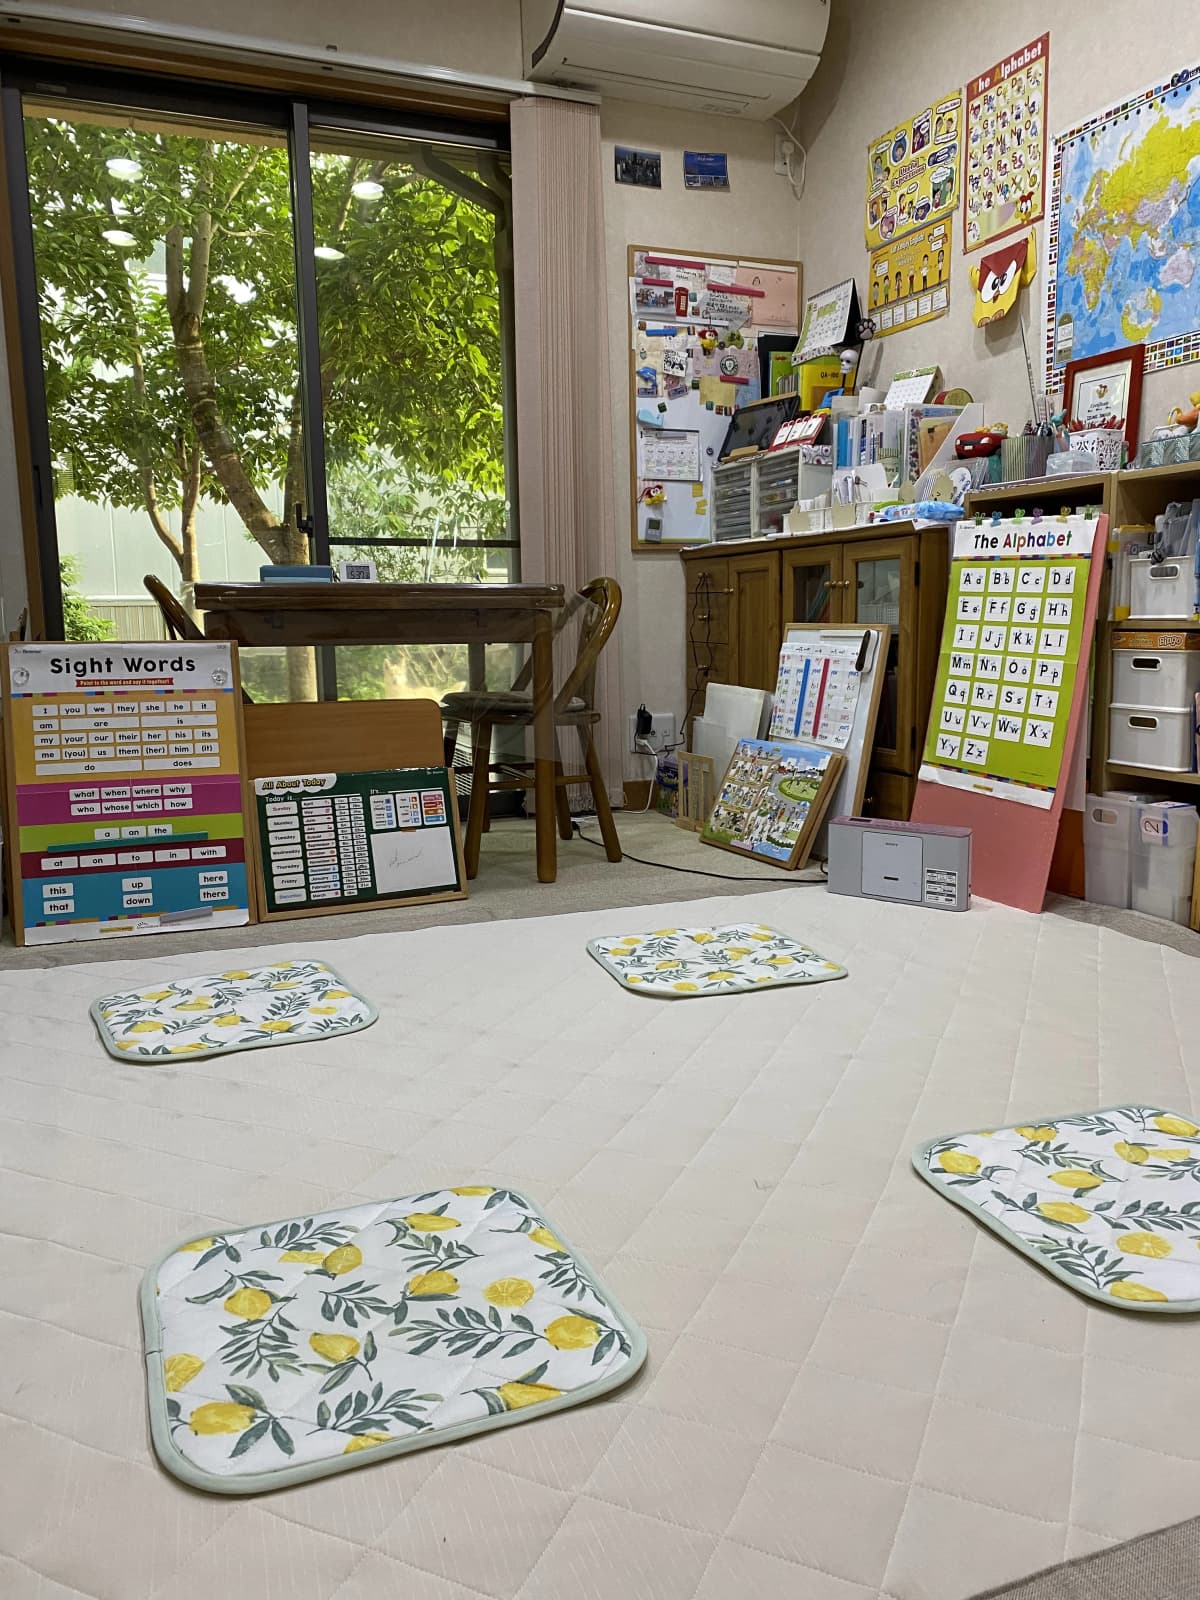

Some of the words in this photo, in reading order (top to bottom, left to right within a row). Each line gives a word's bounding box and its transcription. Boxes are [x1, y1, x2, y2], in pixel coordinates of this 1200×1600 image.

[973, 77, 990, 95] The
[994, 43, 1041, 81] Alphabet
[974, 534, 998, 549] The
[1003, 532, 1072, 552] Alphabet
[1160, 636, 1182, 646] Bingo
[50, 657, 113, 677] Sight
[124, 657, 196, 673] Words
[40, 737, 53, 745] my
[64, 749, 86, 758] (you)
[146, 746, 165, 754] (her)
[201, 744, 213, 752] (it)
[262, 781, 274, 790] All
[276, 780, 300, 789] About
[302, 778, 326, 787] Today
[104, 803, 129, 811] whose
[50, 886, 67, 895] this
[132, 881, 143, 889] up
[203, 874, 223, 882] here
[50, 903, 69, 911] that
[126, 897, 150, 905] down
[203, 890, 226, 898] there
